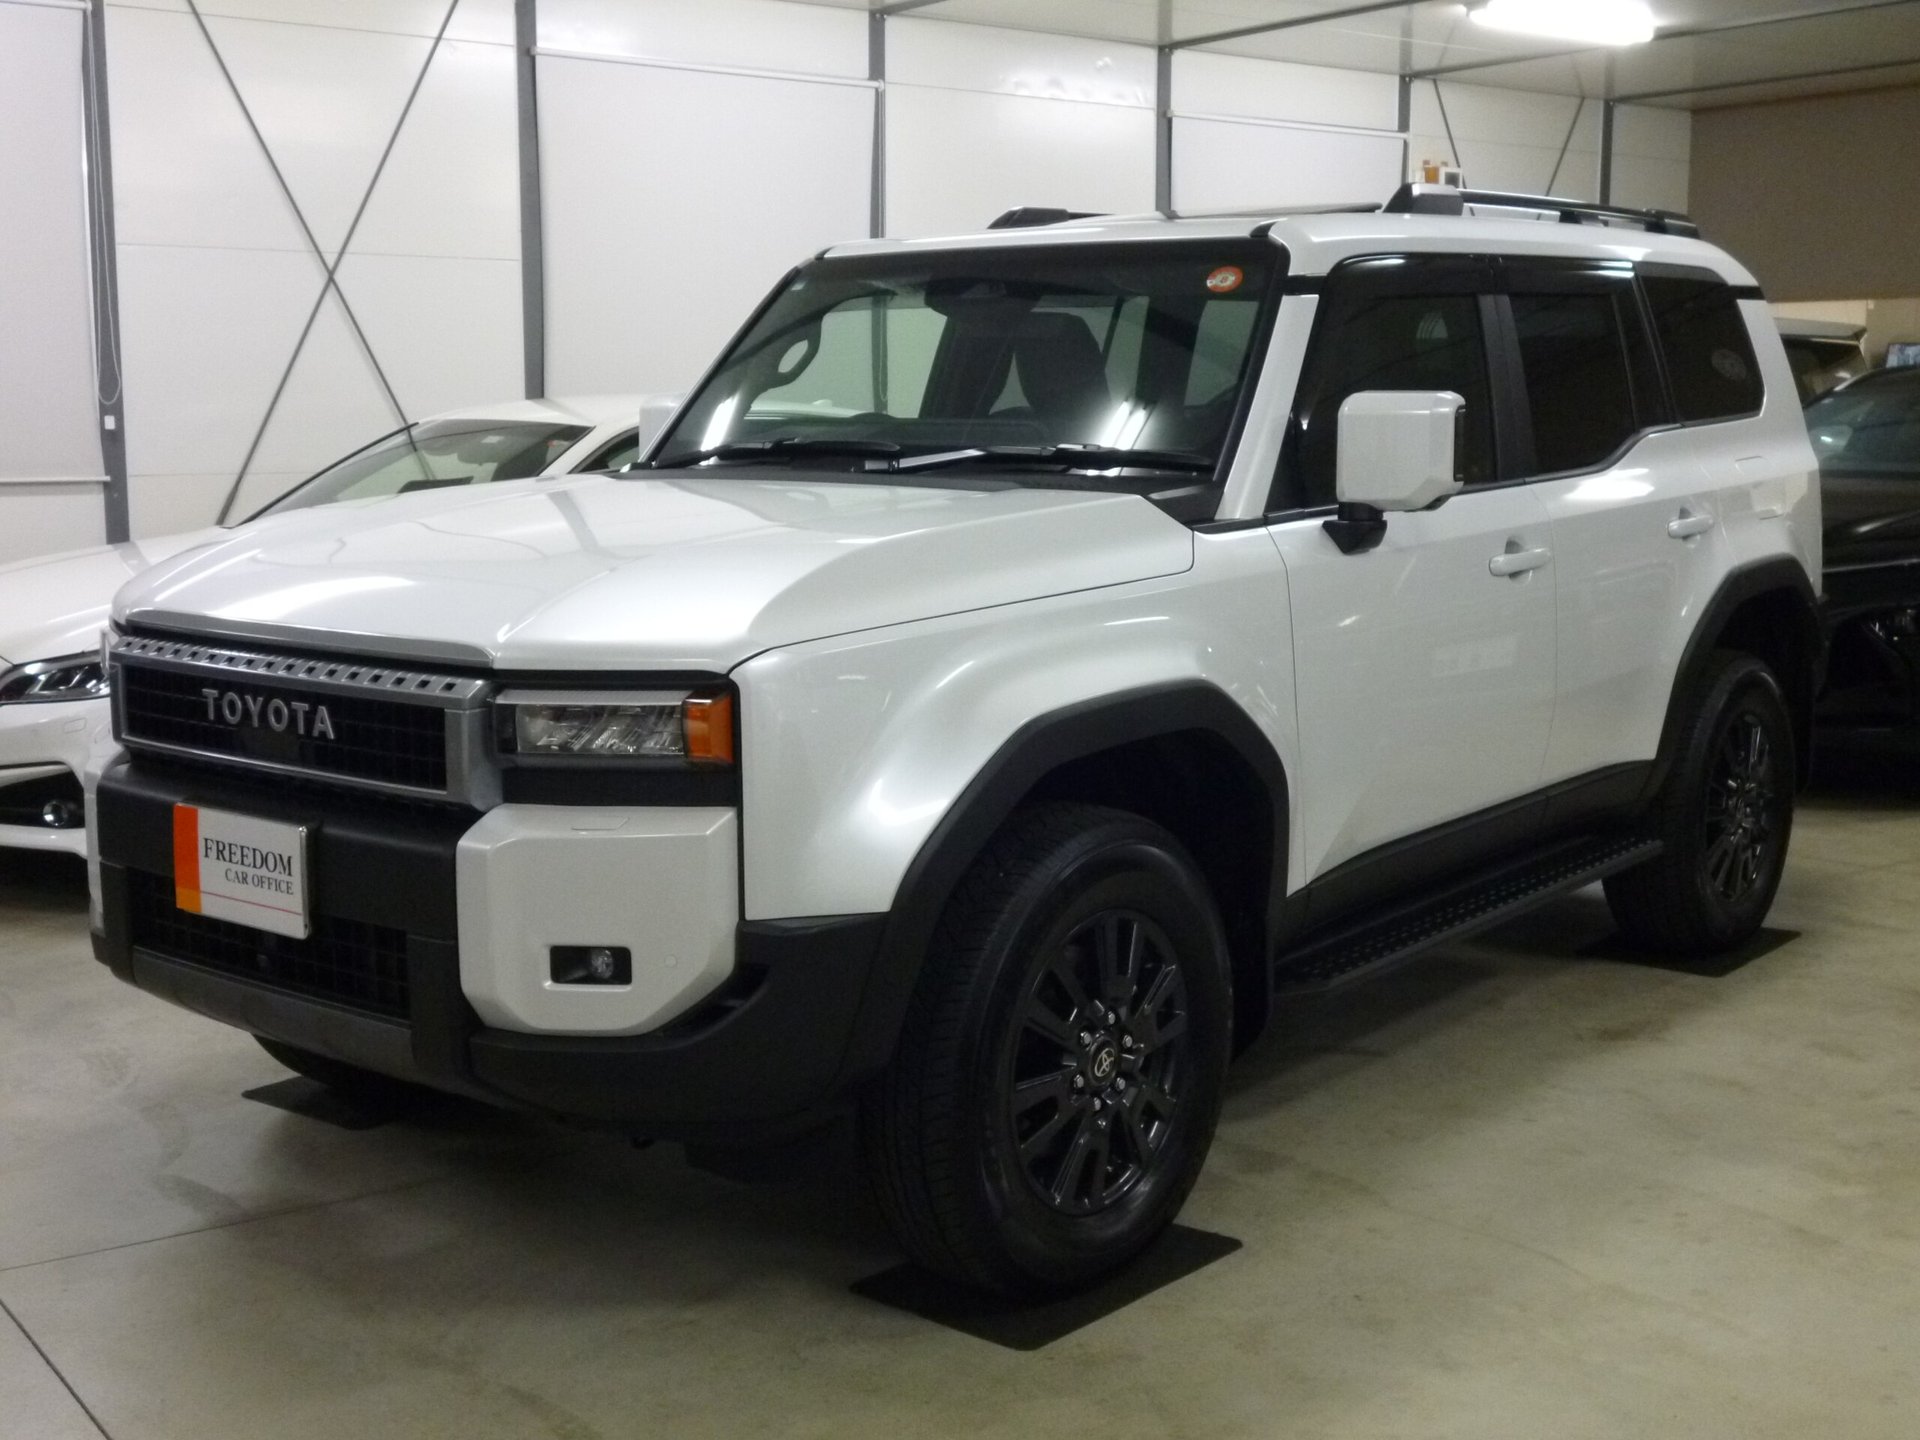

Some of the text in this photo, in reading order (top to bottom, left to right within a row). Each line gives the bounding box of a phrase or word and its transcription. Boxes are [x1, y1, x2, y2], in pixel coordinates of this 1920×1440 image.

[201, 688, 335, 740] TOYOTA
[203, 837, 293, 877] FREEDOM
[225, 867, 294, 895] CAR OFFICE
